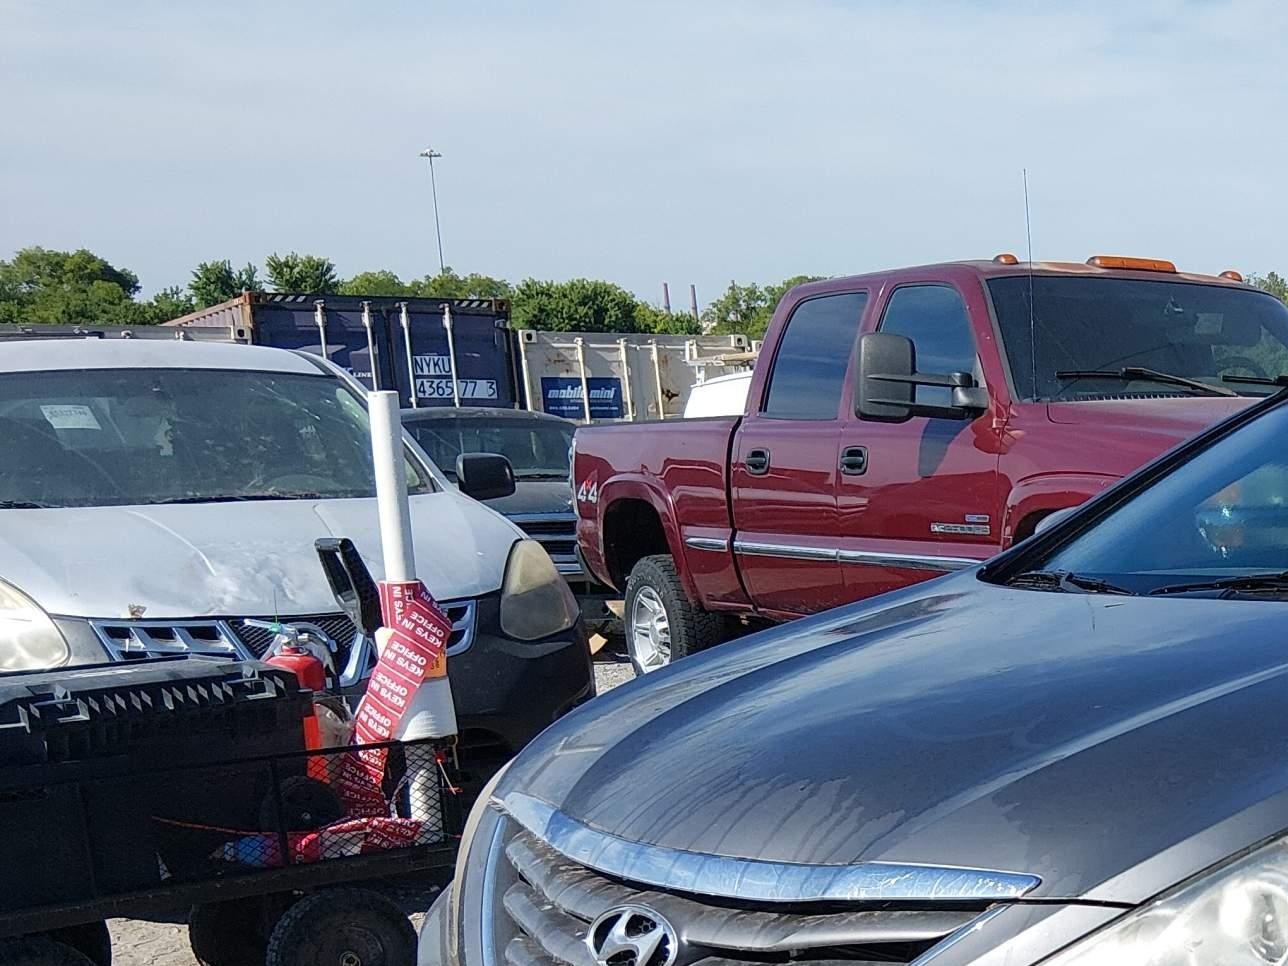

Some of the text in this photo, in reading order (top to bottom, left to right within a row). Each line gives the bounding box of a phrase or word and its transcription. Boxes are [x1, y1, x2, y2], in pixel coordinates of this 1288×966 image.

[415, 357, 451, 373] NYKU
[402, 617, 442, 648] KEYS IN
[410, 610, 445, 638] OFFICE
[384, 648, 397, 660] IN
[390, 640, 427, 666] OFFICE
[396, 656, 425, 677] KEYS
[370, 679, 406, 708] KEYS IN
[375, 672, 408, 697] OFFICE
[363, 702, 392, 728] OFFICE
[367, 718, 390, 738] KEYS
